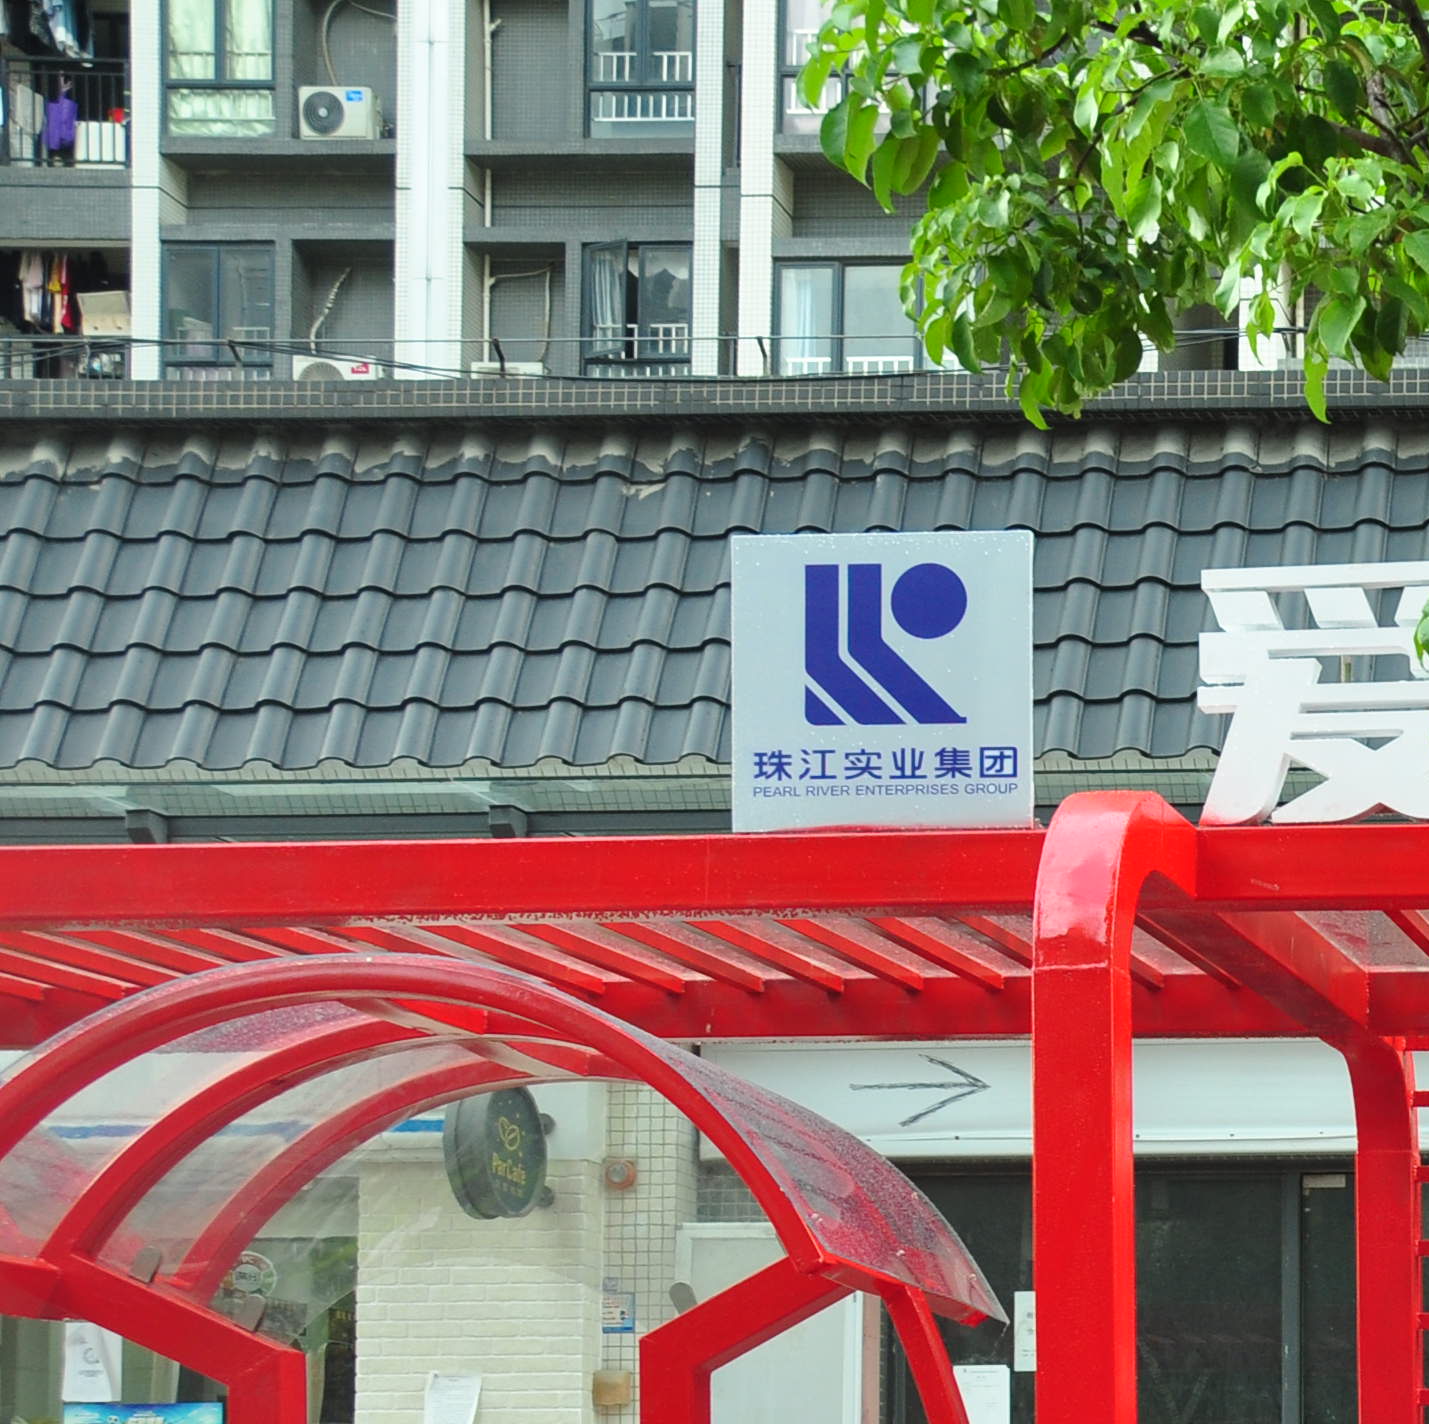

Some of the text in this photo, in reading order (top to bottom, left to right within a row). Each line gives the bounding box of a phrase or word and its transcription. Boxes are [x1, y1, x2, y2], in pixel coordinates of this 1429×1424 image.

[753, 746, 1018, 781] 珠江实业集团
[753, 782, 1018, 797] PEARL RIVER ENTERPRISES GROUP
